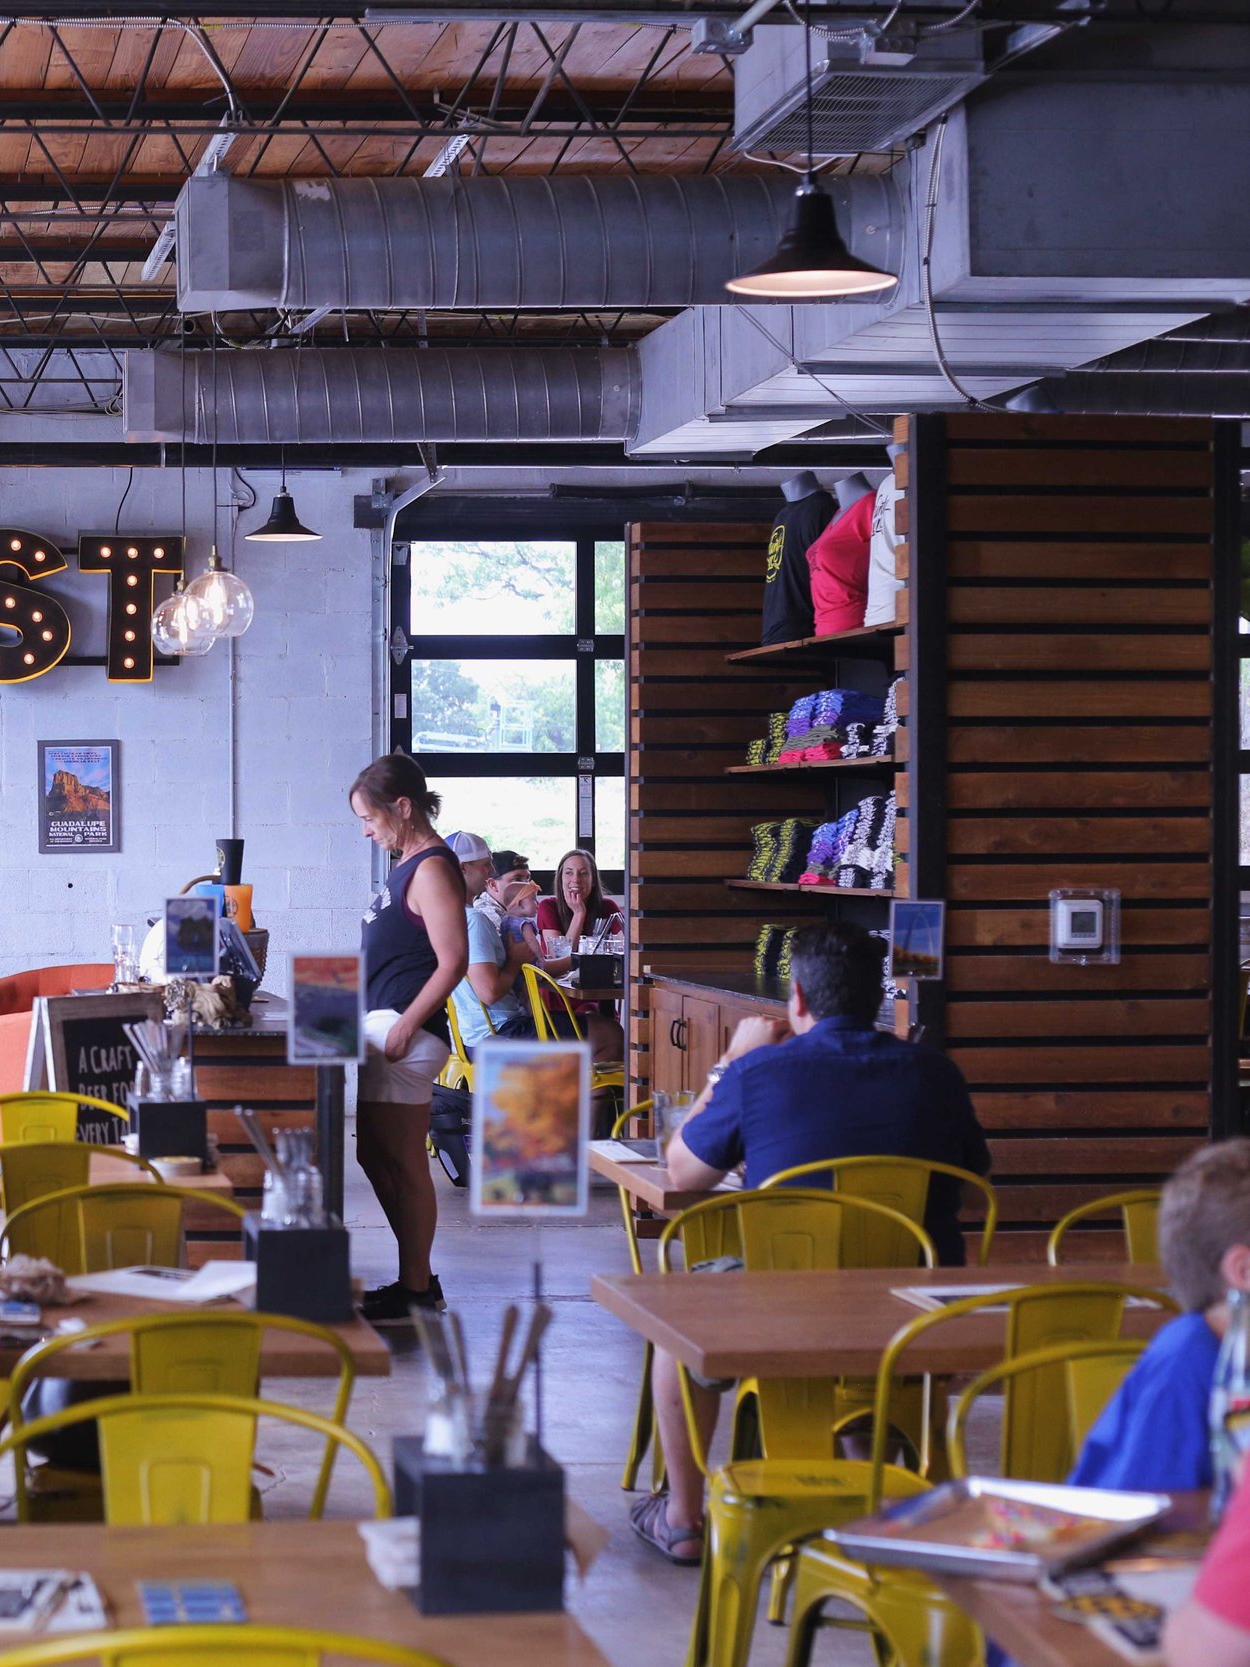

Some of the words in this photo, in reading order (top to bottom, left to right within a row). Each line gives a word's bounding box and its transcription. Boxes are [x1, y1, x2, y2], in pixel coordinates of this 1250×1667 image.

[78, 1046, 88, 1074] A
[90, 1045, 132, 1075] CRAFT
[76, 1121, 109, 1145] VERY
